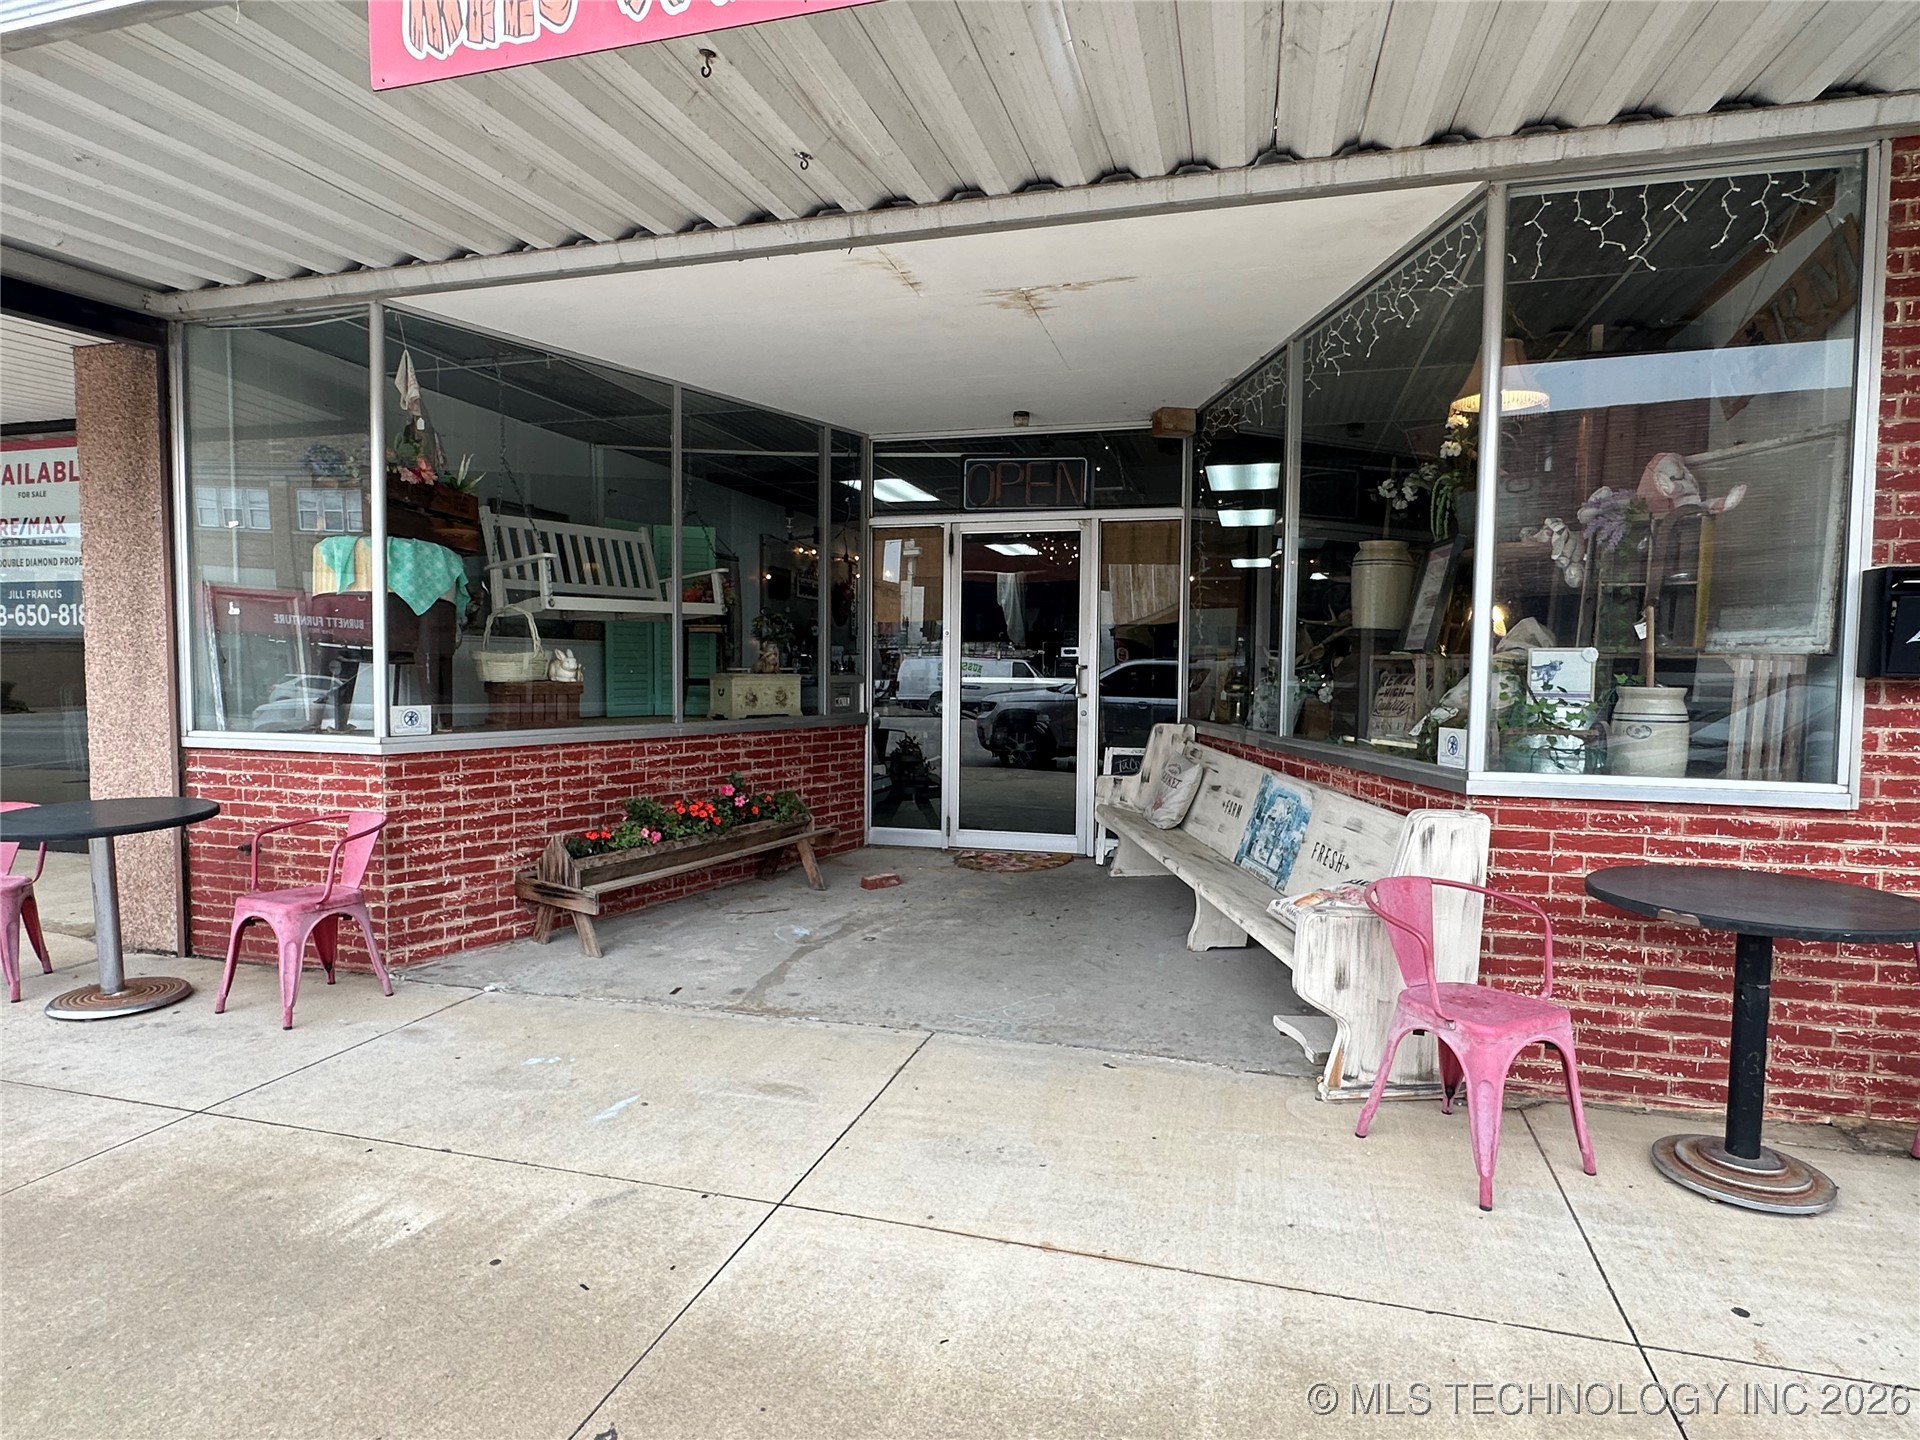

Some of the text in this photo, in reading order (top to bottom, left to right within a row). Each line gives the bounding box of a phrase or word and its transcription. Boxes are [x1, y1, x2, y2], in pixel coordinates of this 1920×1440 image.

[31, 490, 46, 498] SALE
[967, 462, 1085, 506] OPEN
[0, 515, 66, 535] RE/MAX
[25, 557, 58, 567] DIAMOND
[8, 589, 62, 599] JILL FRANCIS
[1224, 799, 1244, 819] FARM
[1311, 841, 1346, 874] FRESH
